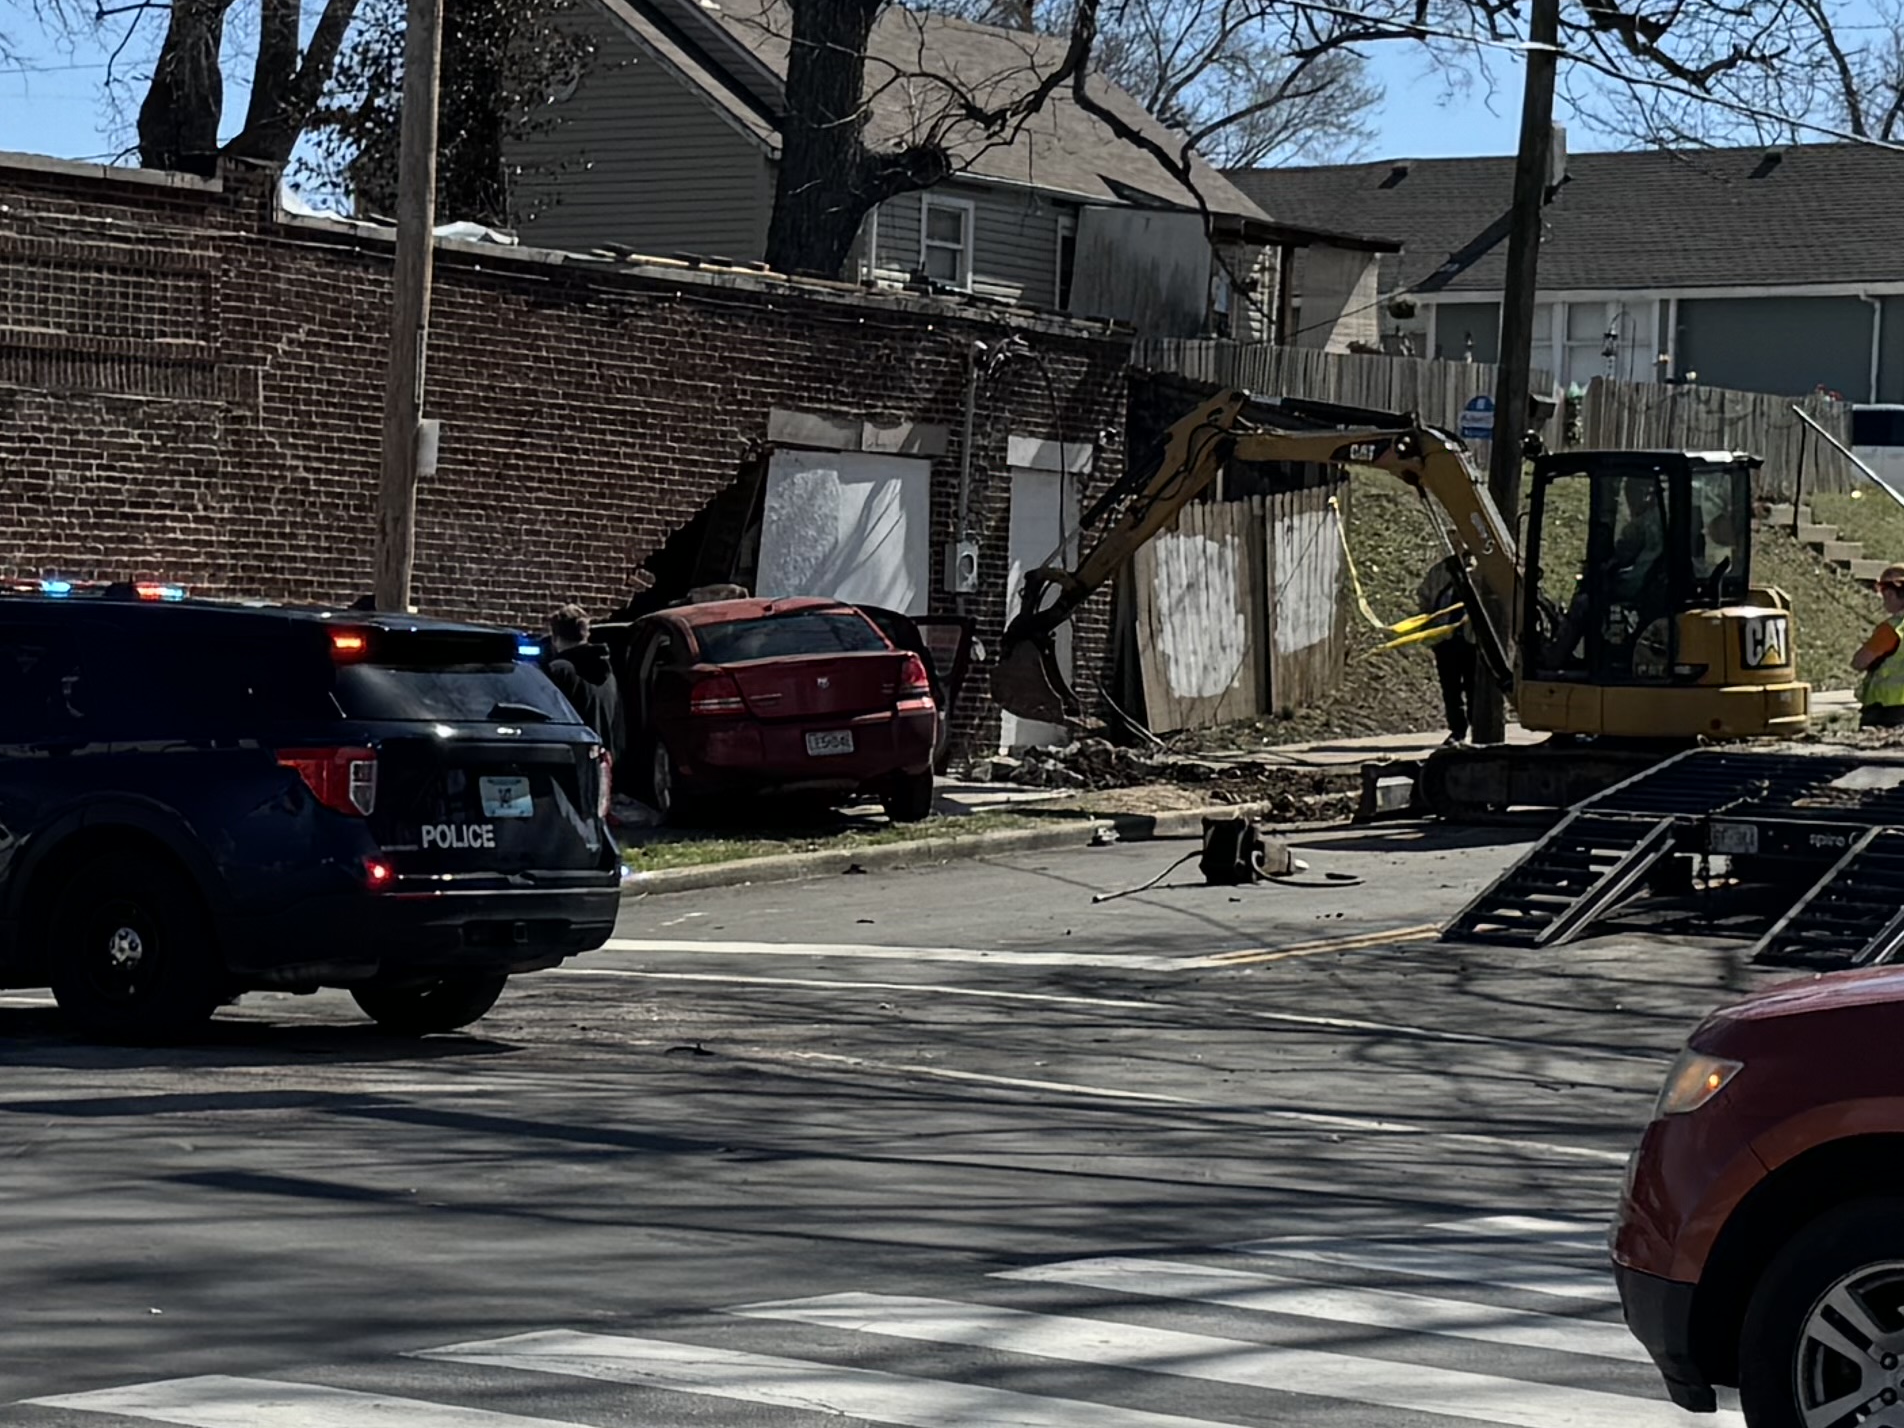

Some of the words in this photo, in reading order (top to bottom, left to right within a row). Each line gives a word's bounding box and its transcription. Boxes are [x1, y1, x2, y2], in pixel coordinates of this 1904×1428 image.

[1349, 444, 1376, 461] CAT
[1745, 618, 1787, 667] CAT
[420, 824, 496, 849] POLICE
